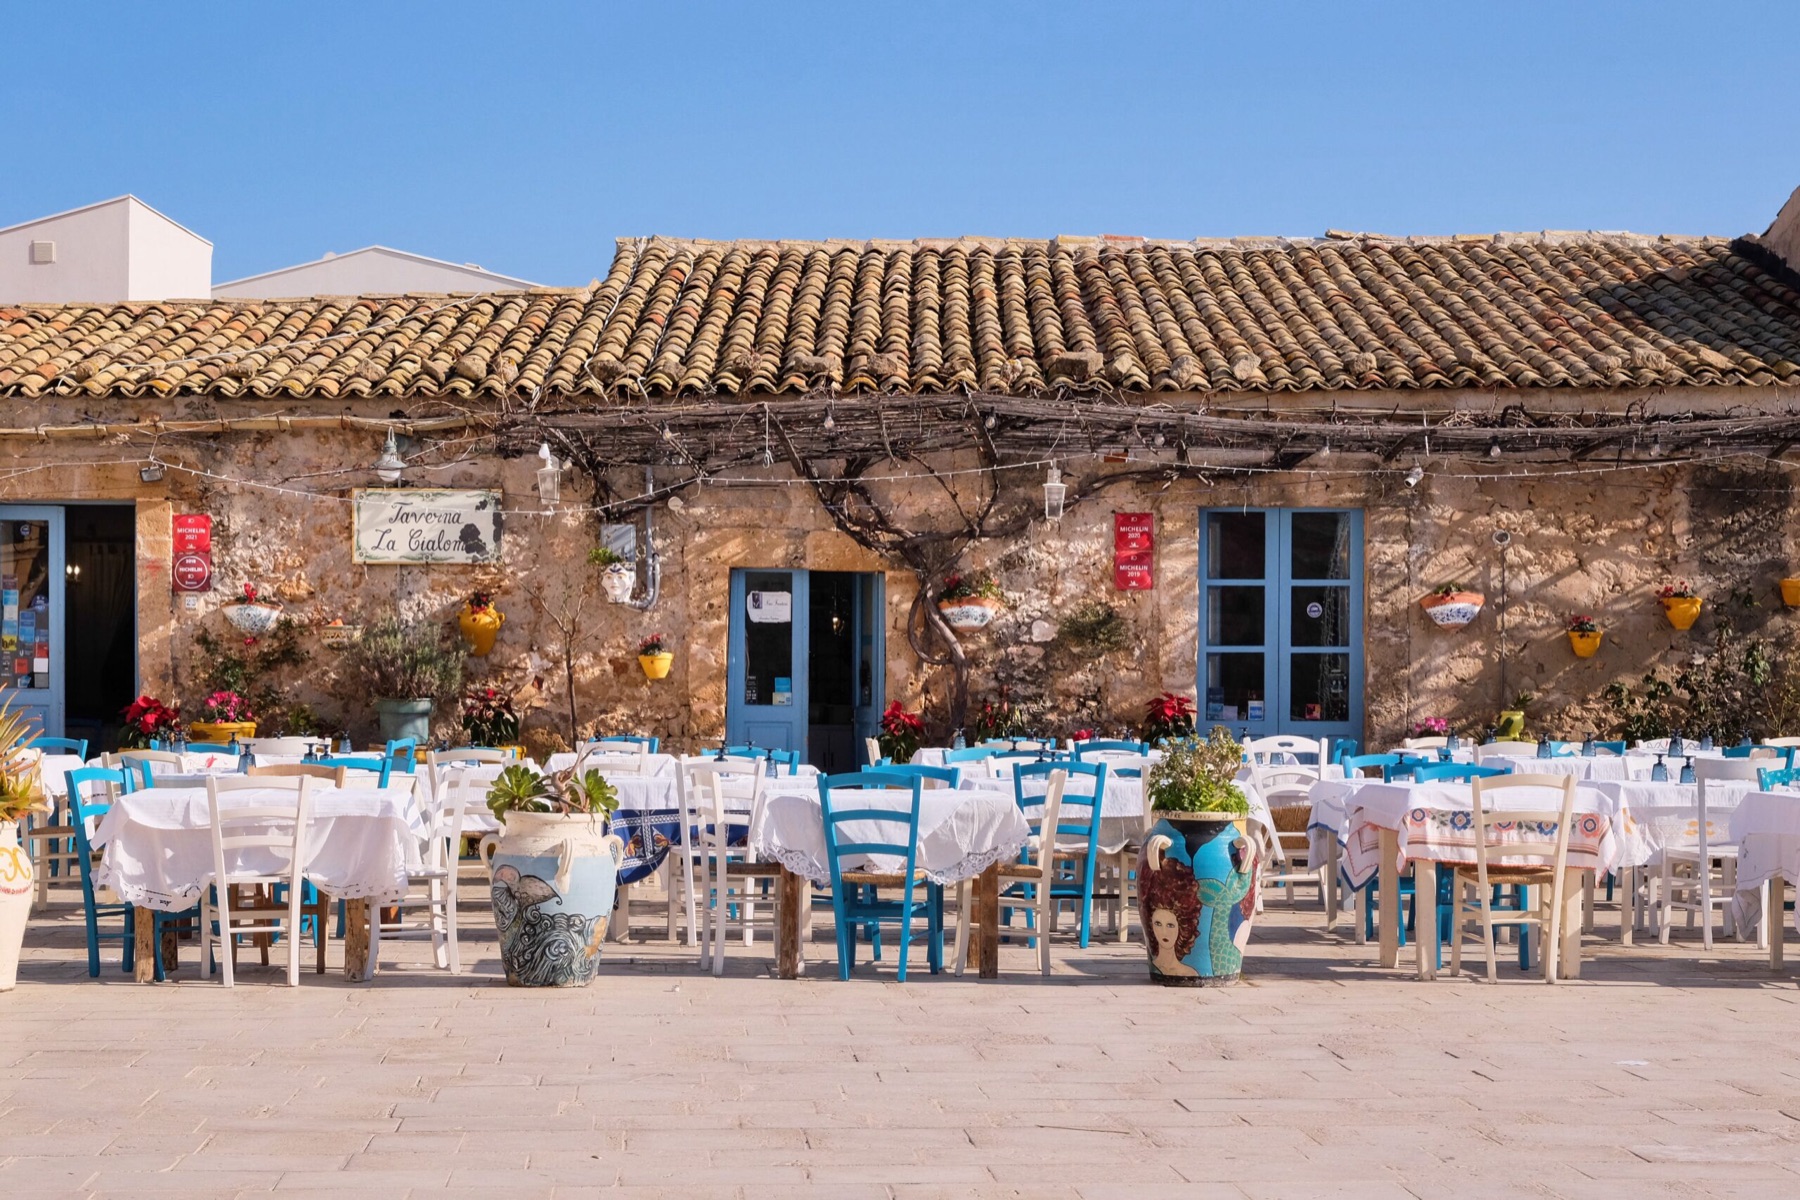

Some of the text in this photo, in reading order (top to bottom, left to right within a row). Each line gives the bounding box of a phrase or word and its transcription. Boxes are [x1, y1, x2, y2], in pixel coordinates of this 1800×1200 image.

[389, 502, 464, 524] Taverna
[371, 528, 469, 552] La Cialom
